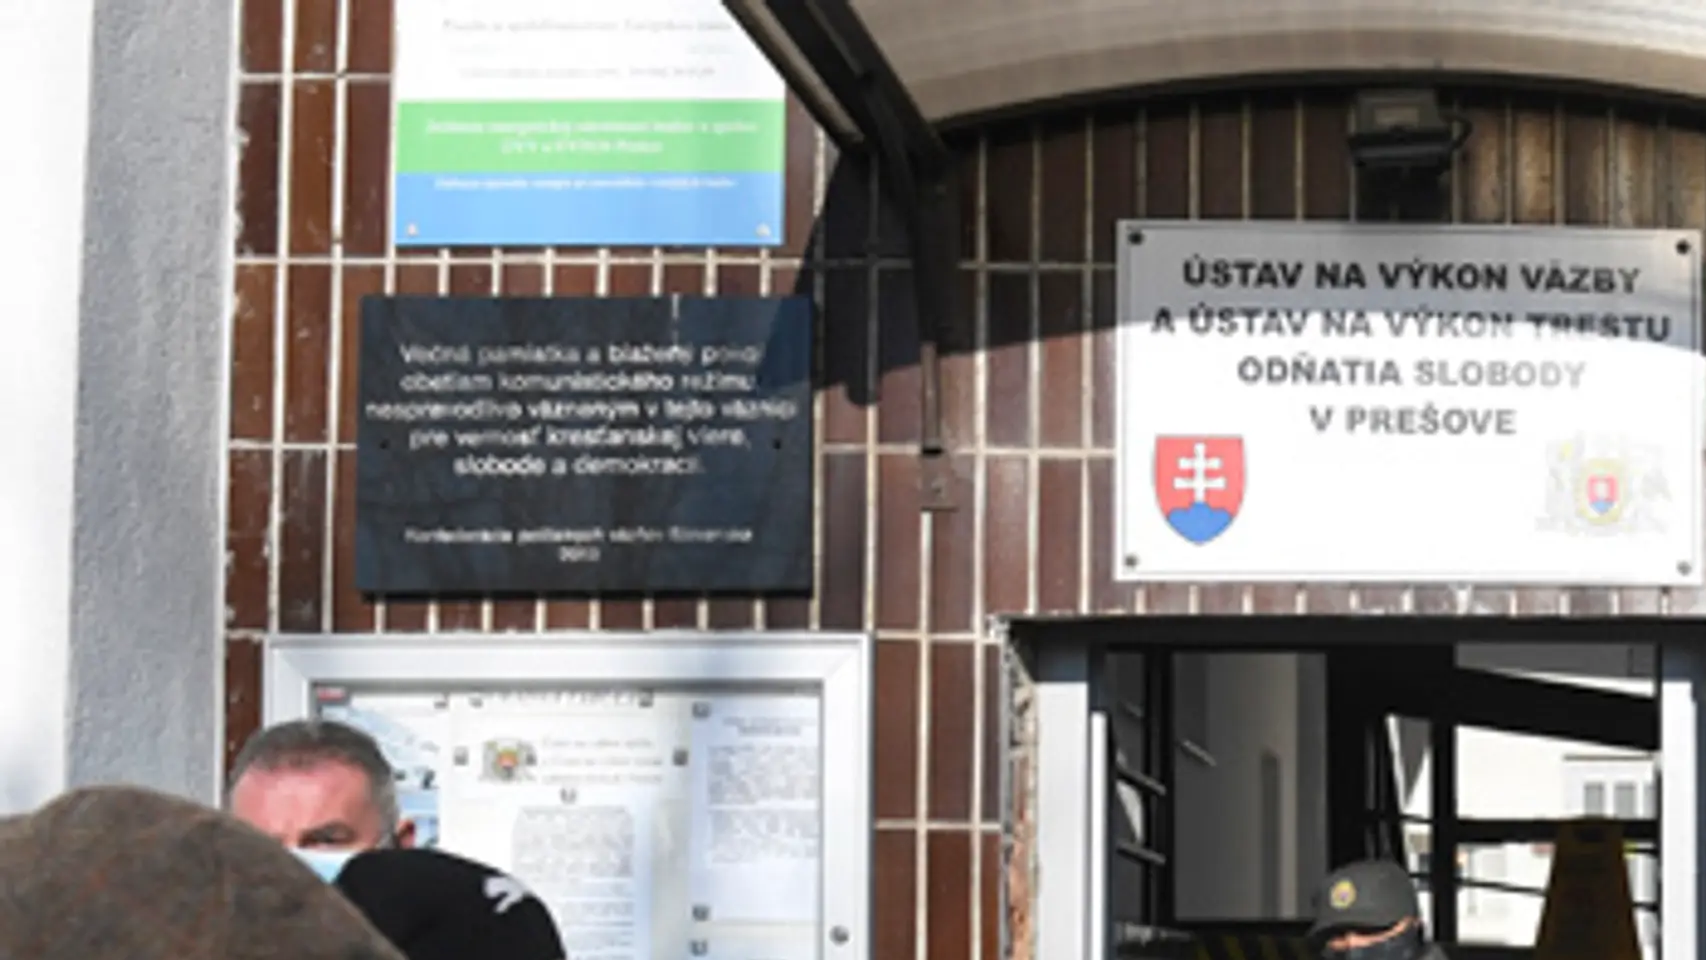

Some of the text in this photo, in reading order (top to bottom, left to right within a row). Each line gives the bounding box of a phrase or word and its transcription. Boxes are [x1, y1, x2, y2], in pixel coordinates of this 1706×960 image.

[1182, 253, 1302, 288] ÚSTAV
[1315, 262, 1367, 289] NA
[1379, 256, 1508, 291] VÝKON
[1151, 301, 1672, 343] A ÚSTAV NA VÝKON TRESTU
[399, 342, 470, 363] Večná
[477, 343, 580, 366] pamiatka
[587, 347, 600, 363] a
[400, 370, 755, 391] obetiam komunistického režimu
[1237, 351, 1587, 388] ODŇATIA SLOBODY
[365, 399, 523, 422] nespravodlivo
[644, 401, 659, 417] v
[1309, 401, 1517, 435] V PREŠOVE
[409, 430, 449, 451] pre
[454, 426, 541, 448] vernosť
[453, 453, 546, 475] slobode
[551, 457, 567, 475] a
